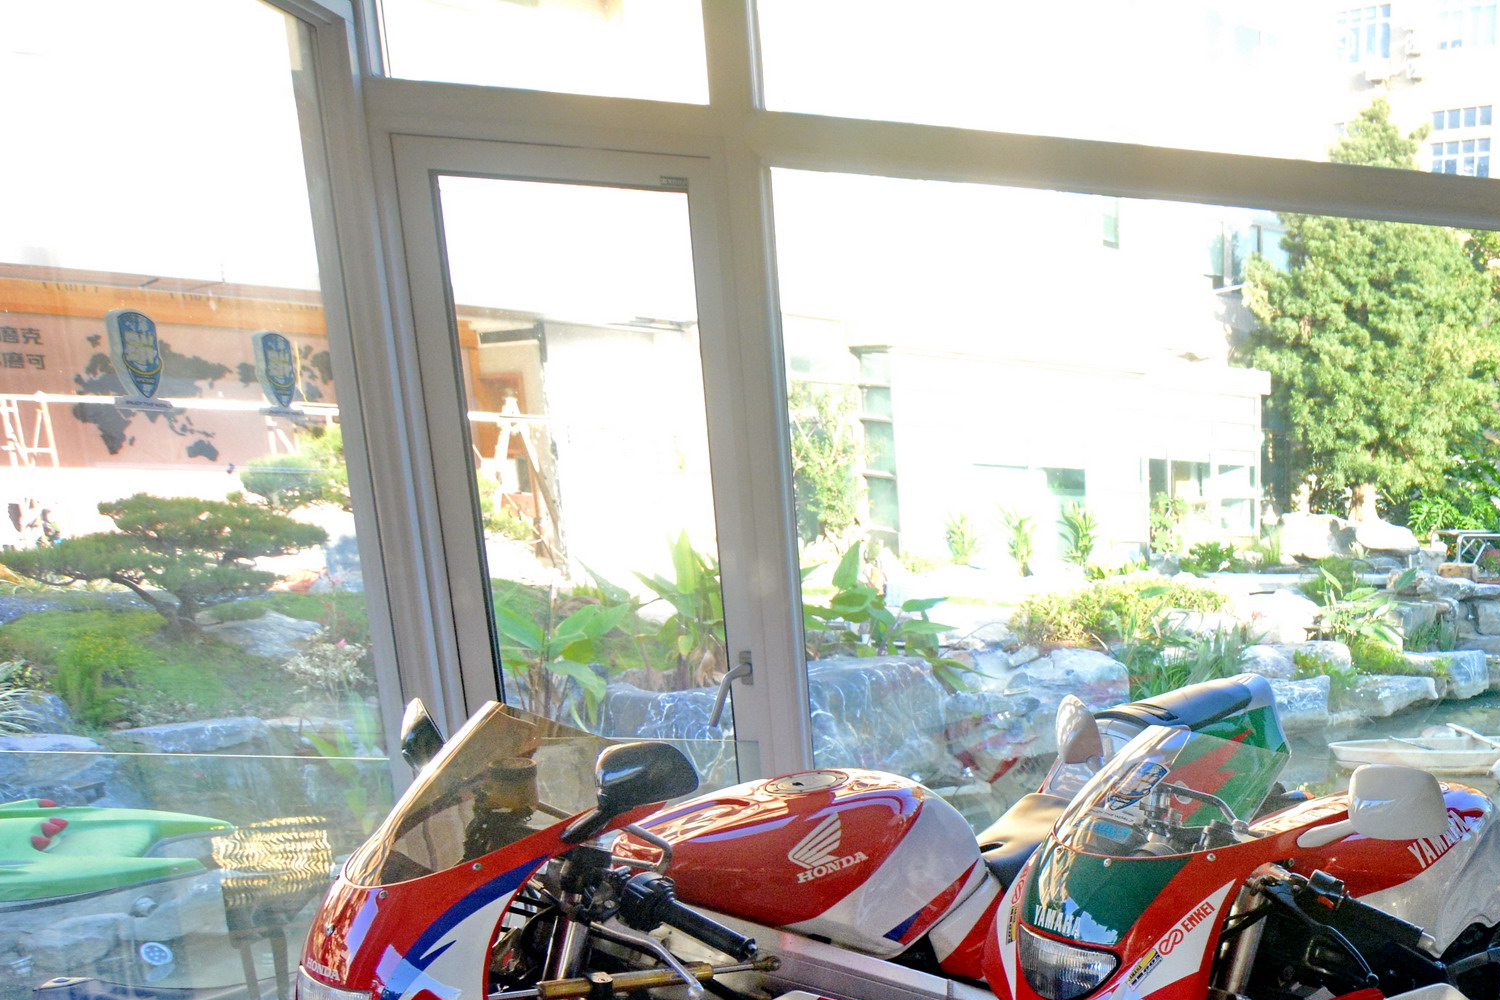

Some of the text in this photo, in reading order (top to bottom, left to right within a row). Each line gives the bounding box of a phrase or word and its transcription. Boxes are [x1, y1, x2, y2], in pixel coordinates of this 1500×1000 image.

[796, 851, 869, 884] HONDA
[1034, 904, 1081, 940] YAMAHA
[1180, 901, 1217, 933] ENKEI
[306, 958, 341, 982] HONDA
